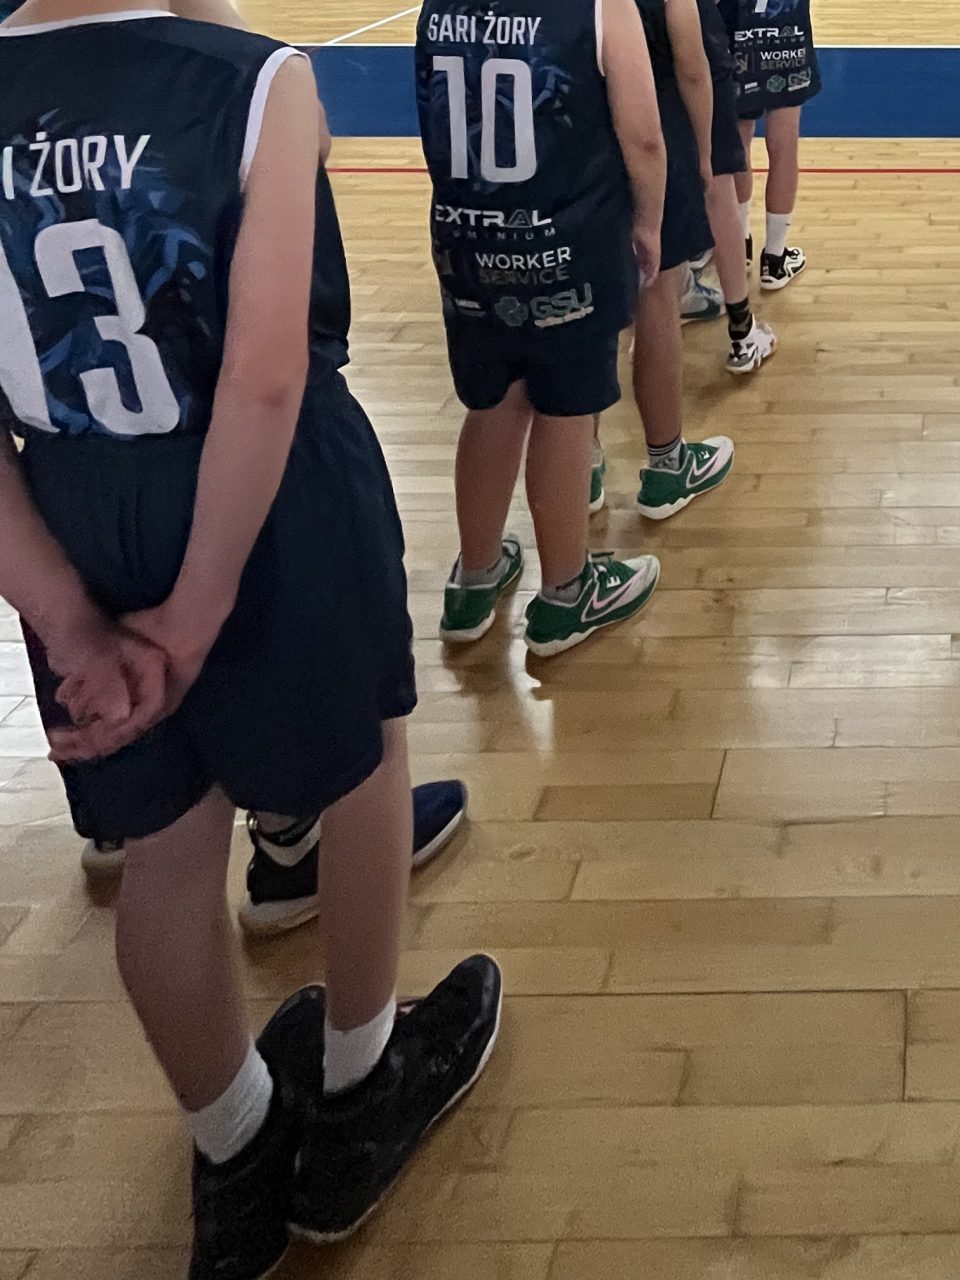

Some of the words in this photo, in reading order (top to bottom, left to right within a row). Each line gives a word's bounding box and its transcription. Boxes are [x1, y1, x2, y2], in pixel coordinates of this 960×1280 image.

[427, 13, 476, 43] SARI
[482, 10, 542, 46] ŻORY
[734, 25, 804, 41] EXTRAL
[760, 48, 806, 60] WORKE
[432, 55, 538, 183] 10
[29, 131, 151, 197] ŻORY
[435, 204, 553, 228] EXTRAL
[475, 246, 572, 270] WORKER
[479, 264, 571, 286] SERVICE
[529, 282, 593, 320] GSU
